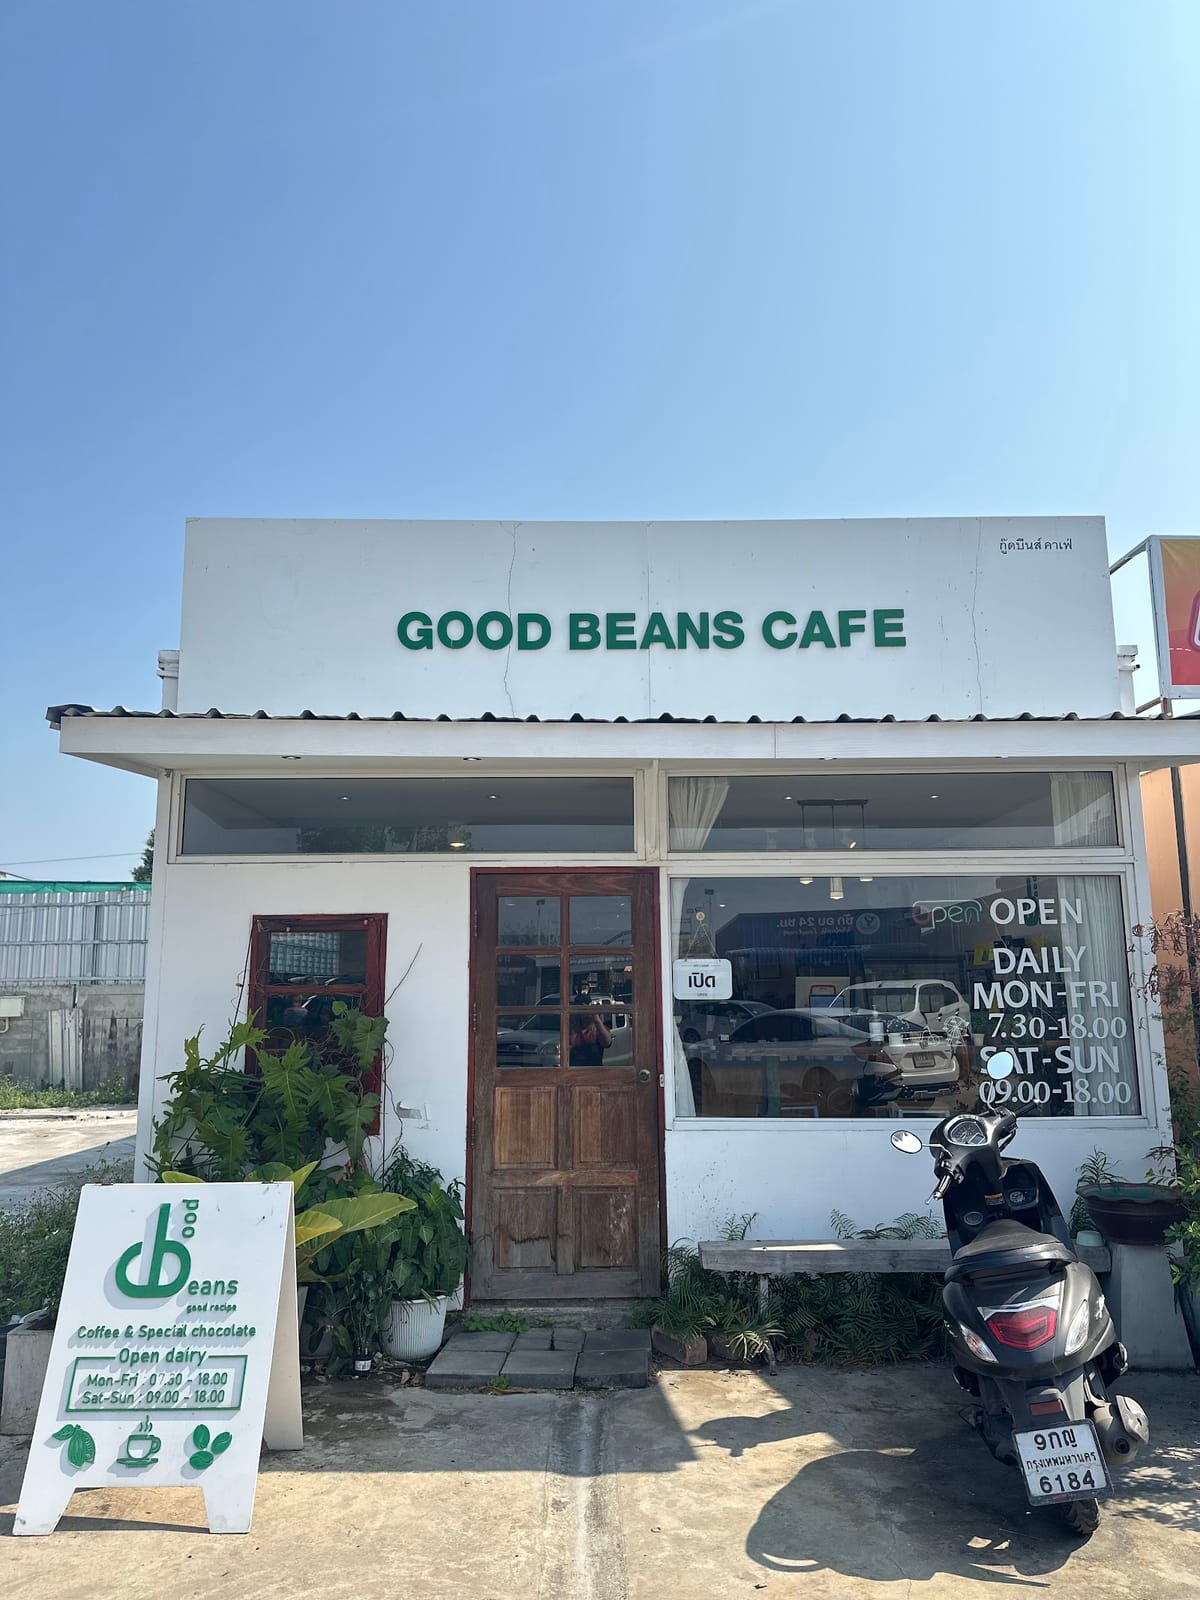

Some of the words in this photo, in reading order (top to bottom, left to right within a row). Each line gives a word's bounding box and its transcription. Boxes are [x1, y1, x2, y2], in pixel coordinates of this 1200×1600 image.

[1044, 538, 1072, 550] คาเฟ่
[397, 610, 551, 650] GOOD
[569, 610, 745, 650] BEANS
[762, 608, 906, 650] CAFE
[990, 897, 1083, 925] OPEN
[993, 945, 1086, 975] DAILY
[688, 972, 716, 988] เปิด
[973, 980, 1119, 1010] MON-FRI
[988, 1013, 1127, 1039] 7.30-18.00
[979, 1078, 1131, 1104] 09.00-18.00
[186, 1303, 208, 1314] good
[77, 1326, 120, 1339] Coffee
[124, 1325, 134, 1338] &
[138, 1324, 187, 1340] Special
[191, 1324, 256, 1337] chocolate
[119, 1348, 160, 1367] Open
[165, 1347, 207, 1366] dairy
[87, 1373, 139, 1387] Mon-Fri
[198, 1372, 228, 1385] 18.00
[82, 1391, 135, 1404] Sat-Sun
[146, 1390, 179, 1403] 09.00
[195, 1389, 225, 1403] 18.00
[1026, 1451, 1097, 1472] กรุงเทพมหานคร
[1039, 1469, 1095, 1494] 6184
